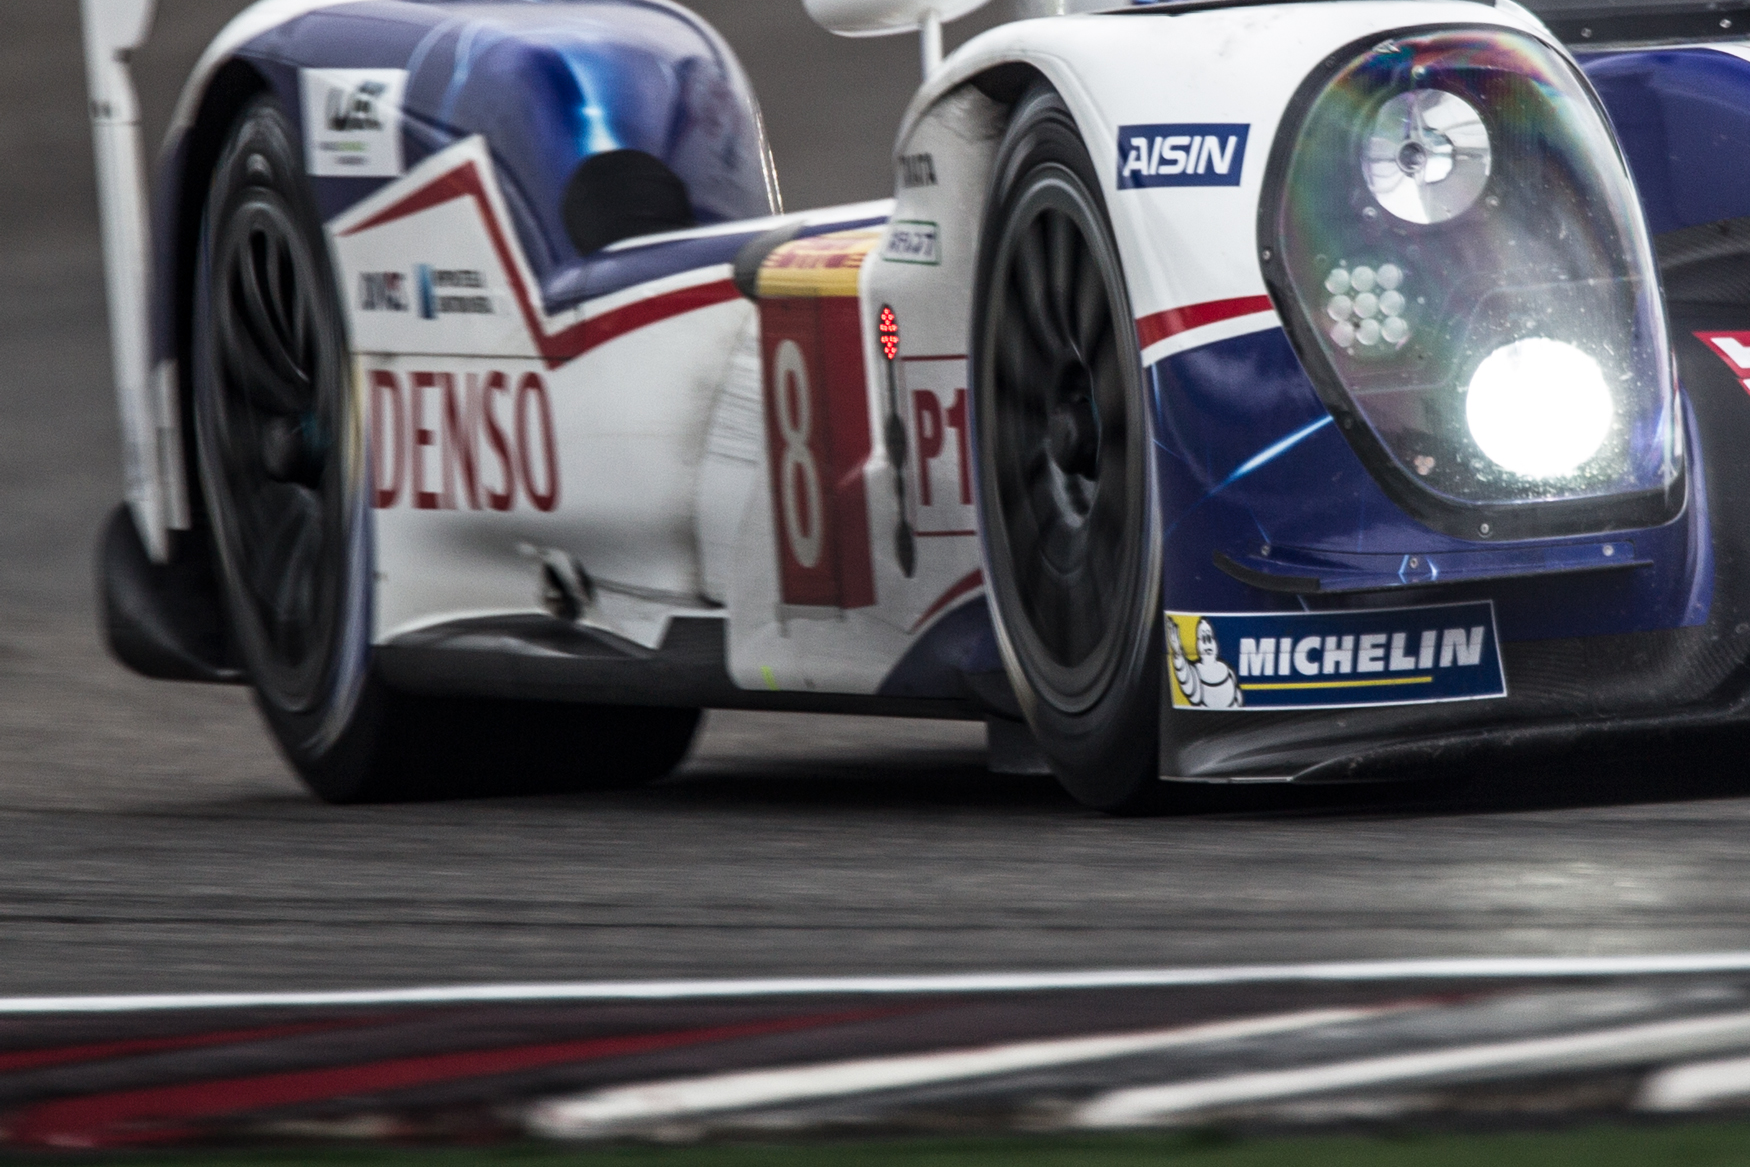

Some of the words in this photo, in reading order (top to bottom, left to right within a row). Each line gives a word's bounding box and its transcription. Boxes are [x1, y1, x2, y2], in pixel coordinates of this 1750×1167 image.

[1123, 134, 1238, 176] AISIN
[368, 369, 562, 513] DENSO
[772, 338, 824, 569] 8
[912, 387, 973, 508] P1
[1238, 626, 1486, 677] MICHELIN
